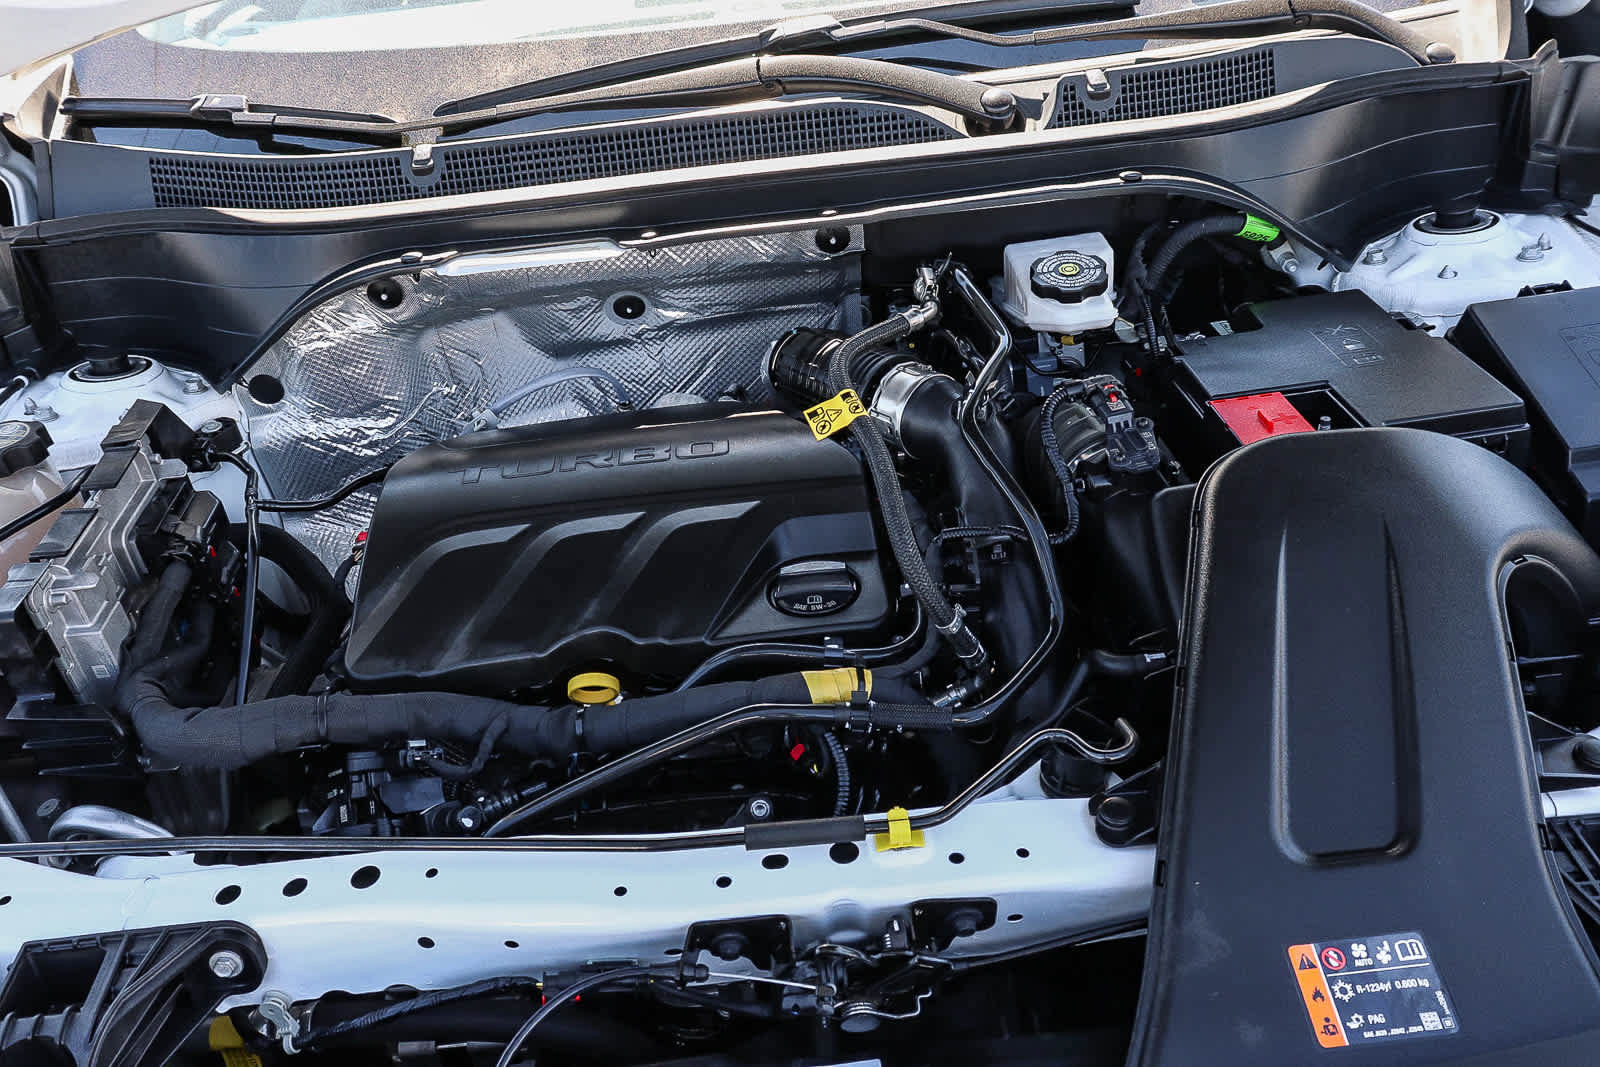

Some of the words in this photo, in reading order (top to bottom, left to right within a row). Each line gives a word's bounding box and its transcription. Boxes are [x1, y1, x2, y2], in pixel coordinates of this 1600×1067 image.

[448, 439, 730, 485] TURBO
[1354, 958, 1374, 967] AUTO
[1355, 981, 1392, 994] R-1234yf
[1417, 977, 1430, 988] kg
[1367, 1013, 1386, 1024] PAG
